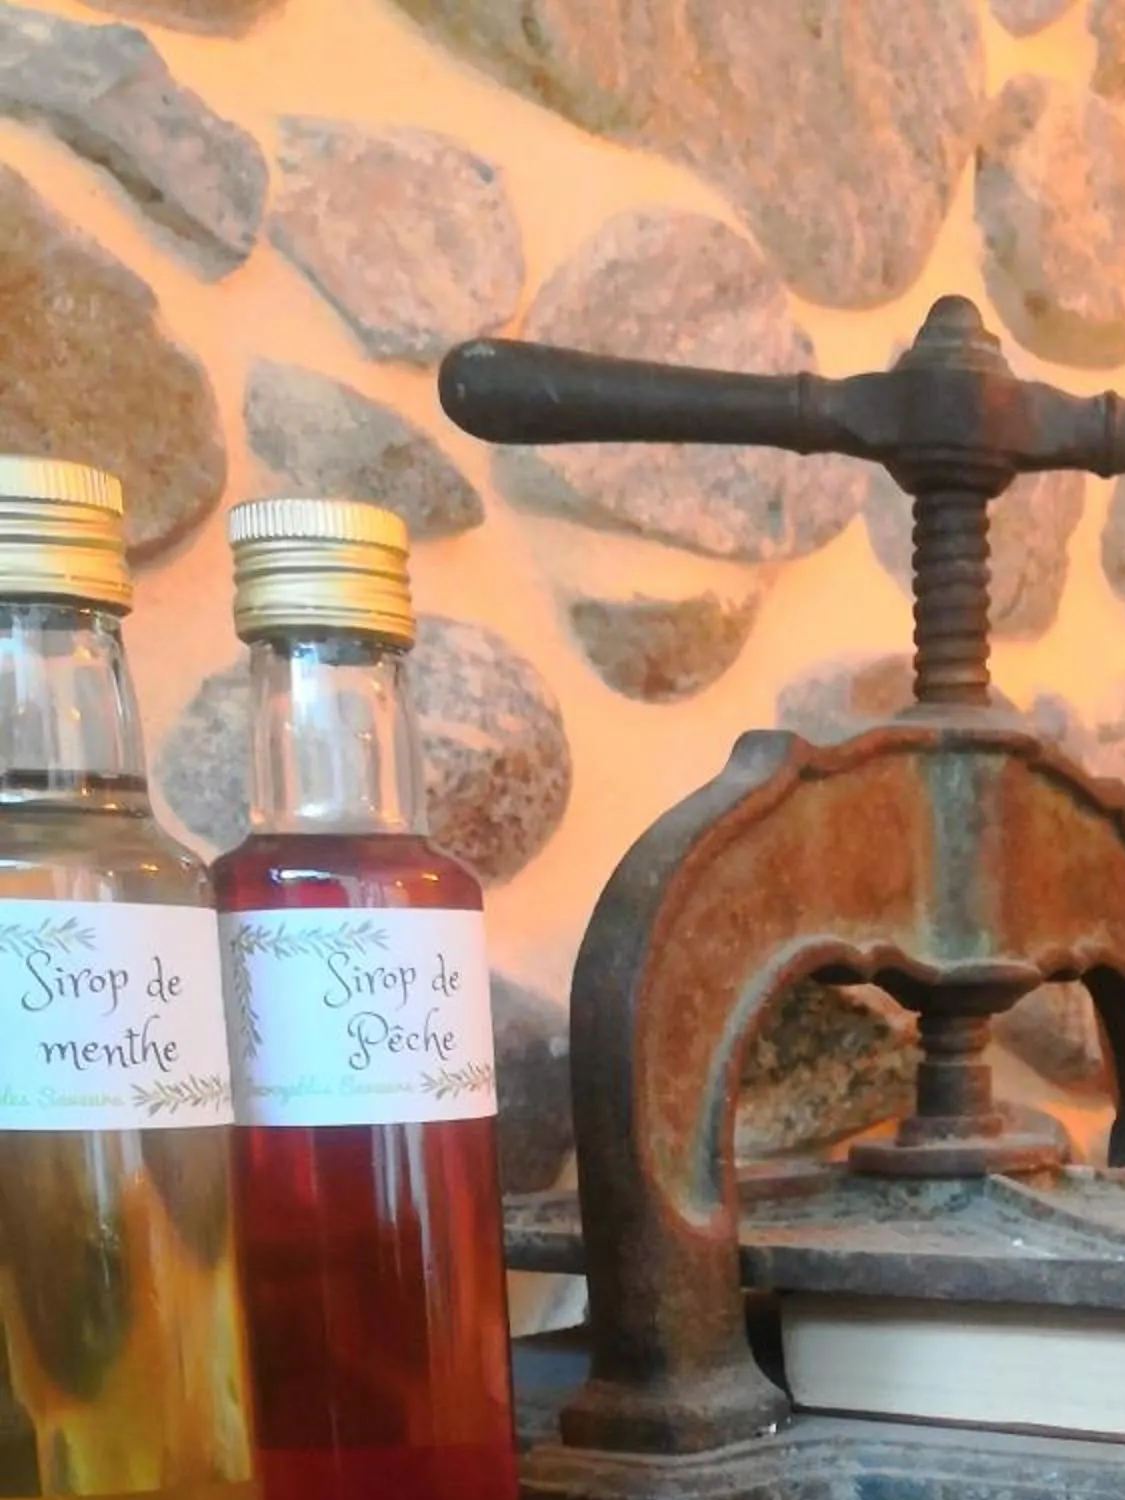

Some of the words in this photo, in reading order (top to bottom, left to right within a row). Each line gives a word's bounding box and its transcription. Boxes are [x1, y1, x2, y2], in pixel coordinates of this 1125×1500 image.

[20, 950, 130, 1016] Sirop
[146, 956, 183, 1003] de
[323, 951, 418, 1010] Sirop
[431, 953, 460, 996] de
[40, 1014, 180, 1072] menthe
[347, 1008, 459, 1070] Pêche
